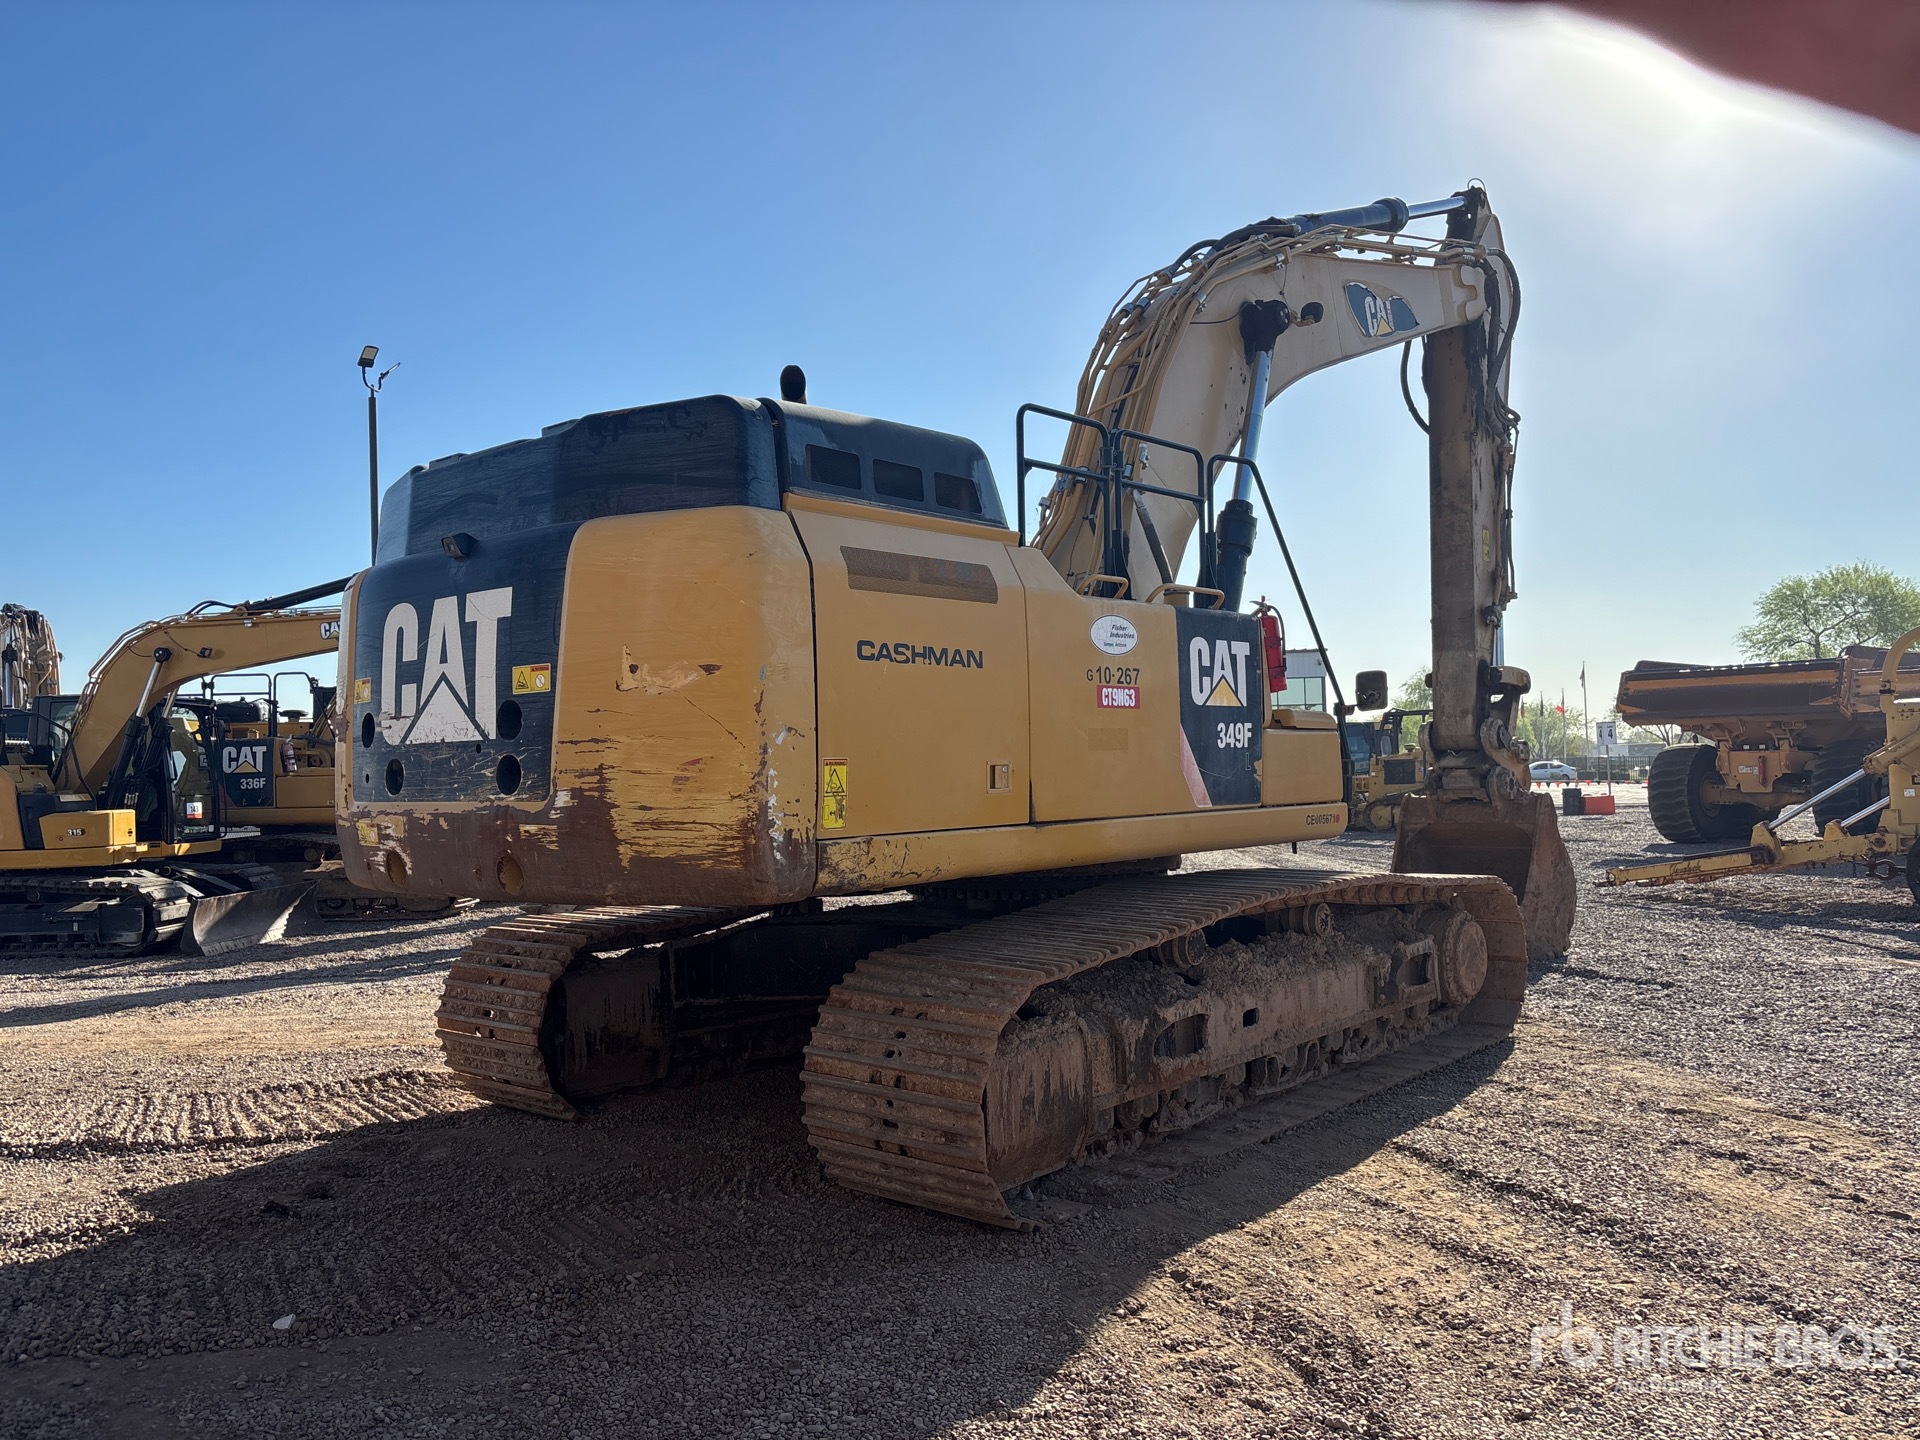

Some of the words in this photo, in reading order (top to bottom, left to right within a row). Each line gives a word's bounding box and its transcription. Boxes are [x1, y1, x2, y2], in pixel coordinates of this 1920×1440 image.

[321, 622, 340, 639] CA
[381, 587, 513, 745] CAT
[857, 640, 983, 669] CASHMAN
[1086, 669, 1094, 681] G
[1190, 636, 1250, 707] CAT
[1102, 687, 1136, 707] CT9N63
[1217, 723, 1252, 749] 349F
[223, 745, 267, 774] CAT
[240, 778, 266, 790] 336F
[67, 828, 82, 837] 315
